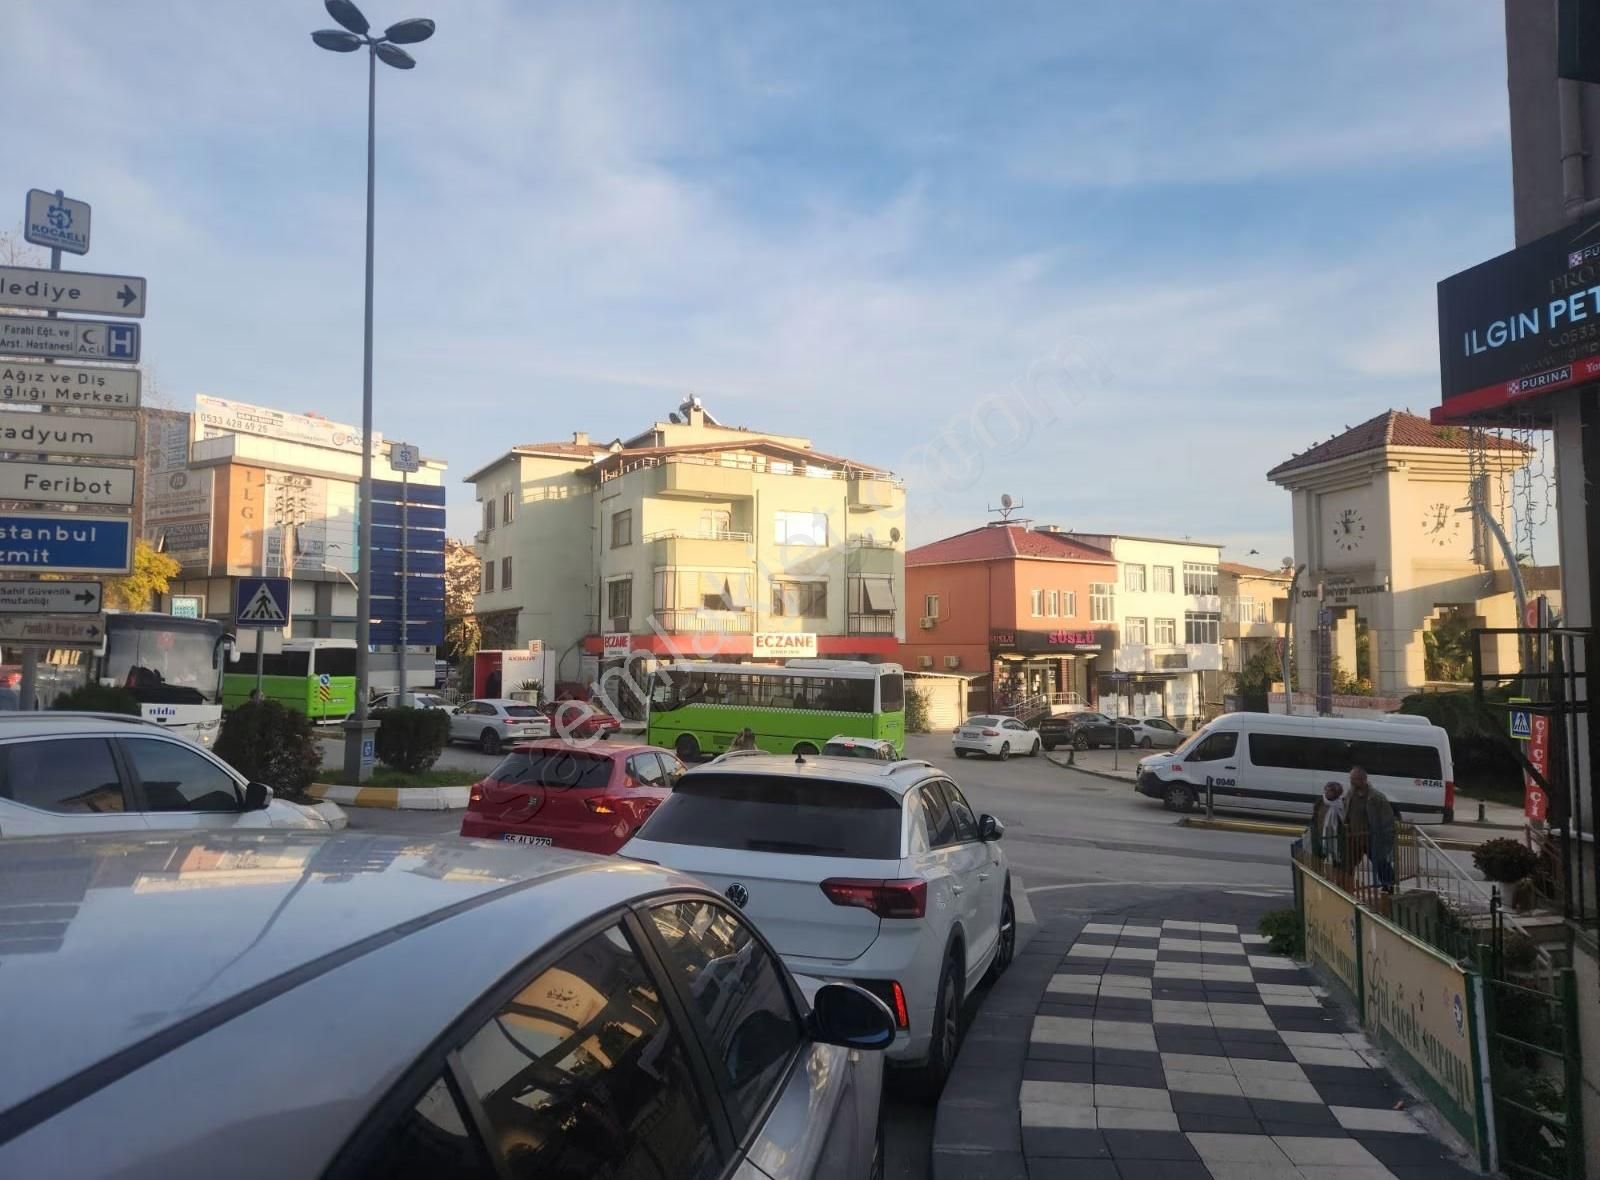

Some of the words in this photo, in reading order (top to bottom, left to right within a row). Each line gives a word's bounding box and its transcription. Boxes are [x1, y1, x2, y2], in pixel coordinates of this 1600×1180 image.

[0, 277, 81, 303] lediye
[1464, 307, 1540, 357] ILGIN
[1549, 285, 1600, 329] PET
[59, 329, 70, 337] ve
[26, 340, 73, 351] Hastanesi
[2, 368, 44, 384] Ağız
[50, 374, 71, 383] ve
[78, 373, 105, 386] Diş
[1521, 369, 1568, 390] PURINA
[55, 388, 129, 403] Merkezi
[200, 412, 223, 425] 0533
[226, 418, 242, 430] 428
[24, 473, 112, 495] Feribot
[604, 635, 628, 648] ECZANE
[756, 635, 814, 648] ECZANE
